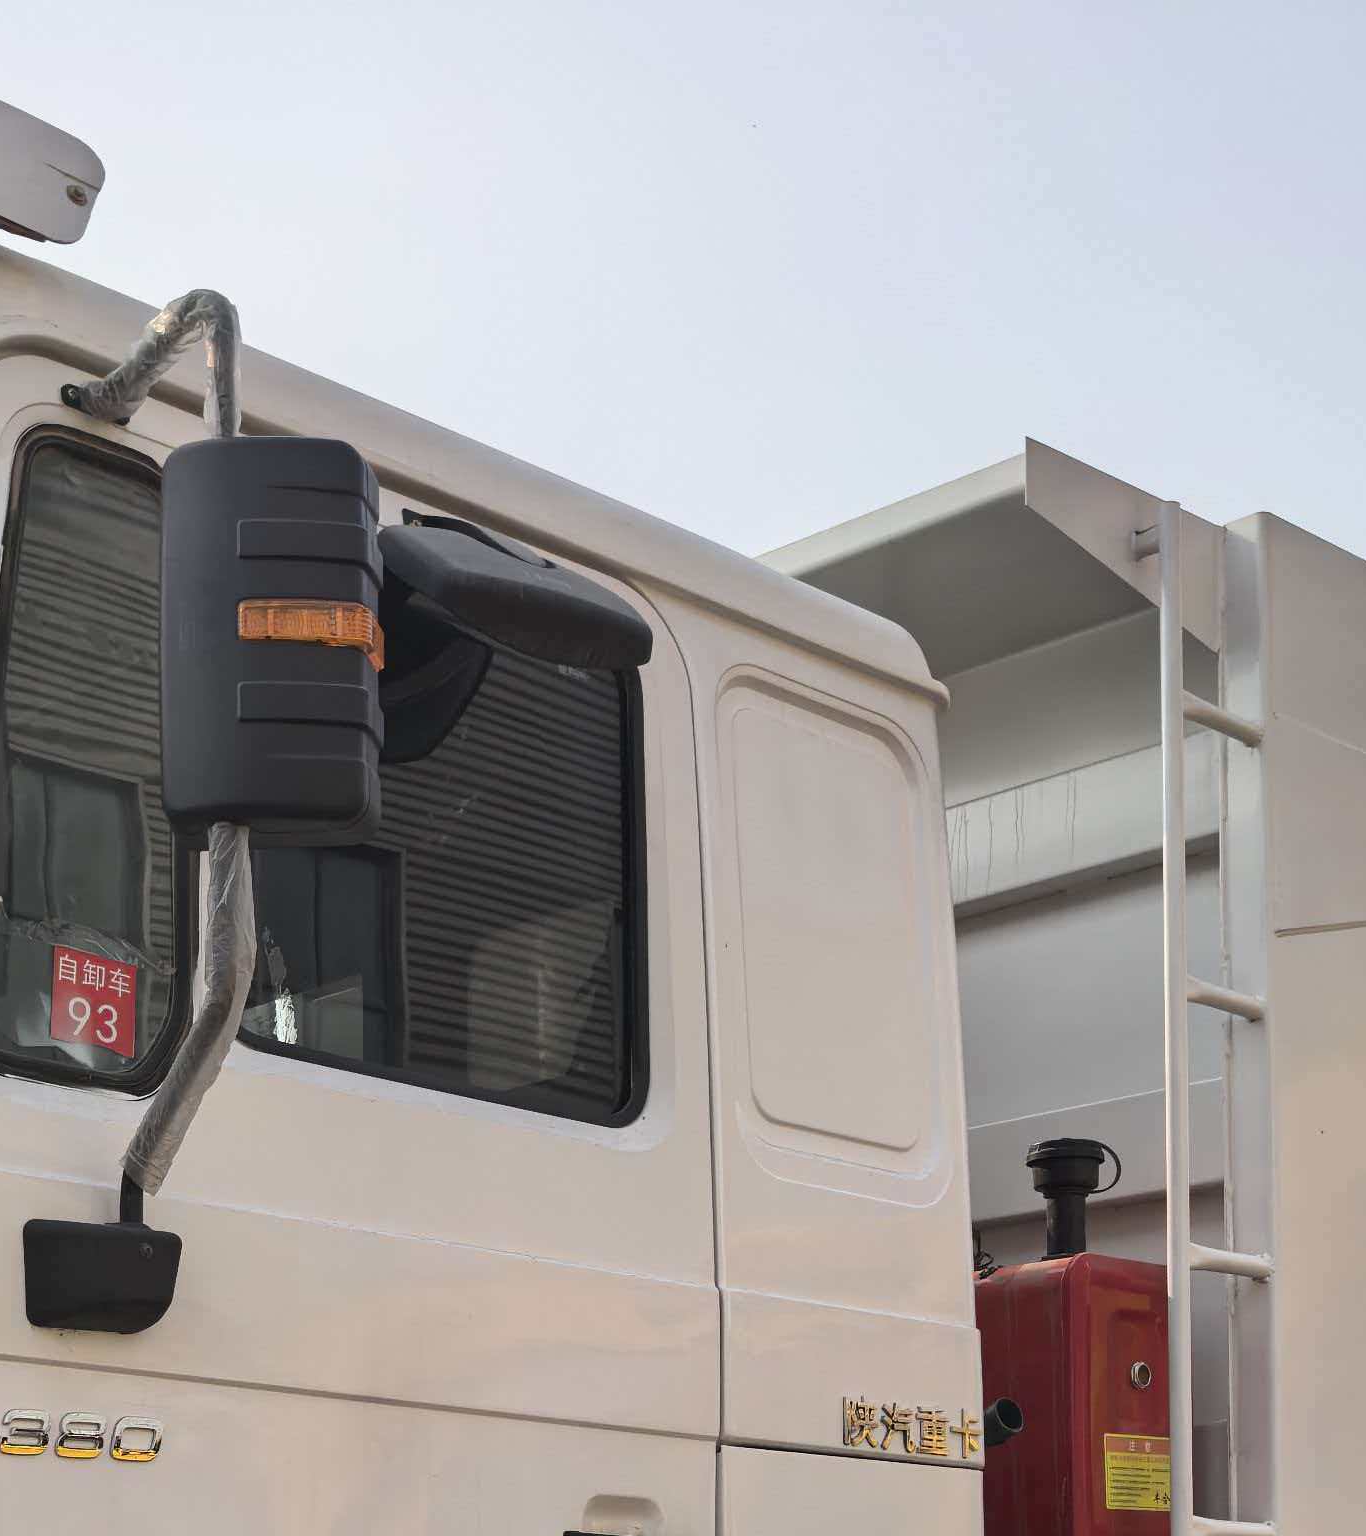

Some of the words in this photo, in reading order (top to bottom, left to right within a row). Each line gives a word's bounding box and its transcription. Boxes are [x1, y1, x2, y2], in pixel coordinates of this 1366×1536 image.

[58, 954, 132, 998] 自卸车
[68, 997, 118, 1044] 93
[842, 1396, 982, 1459] 陕汽重卡
